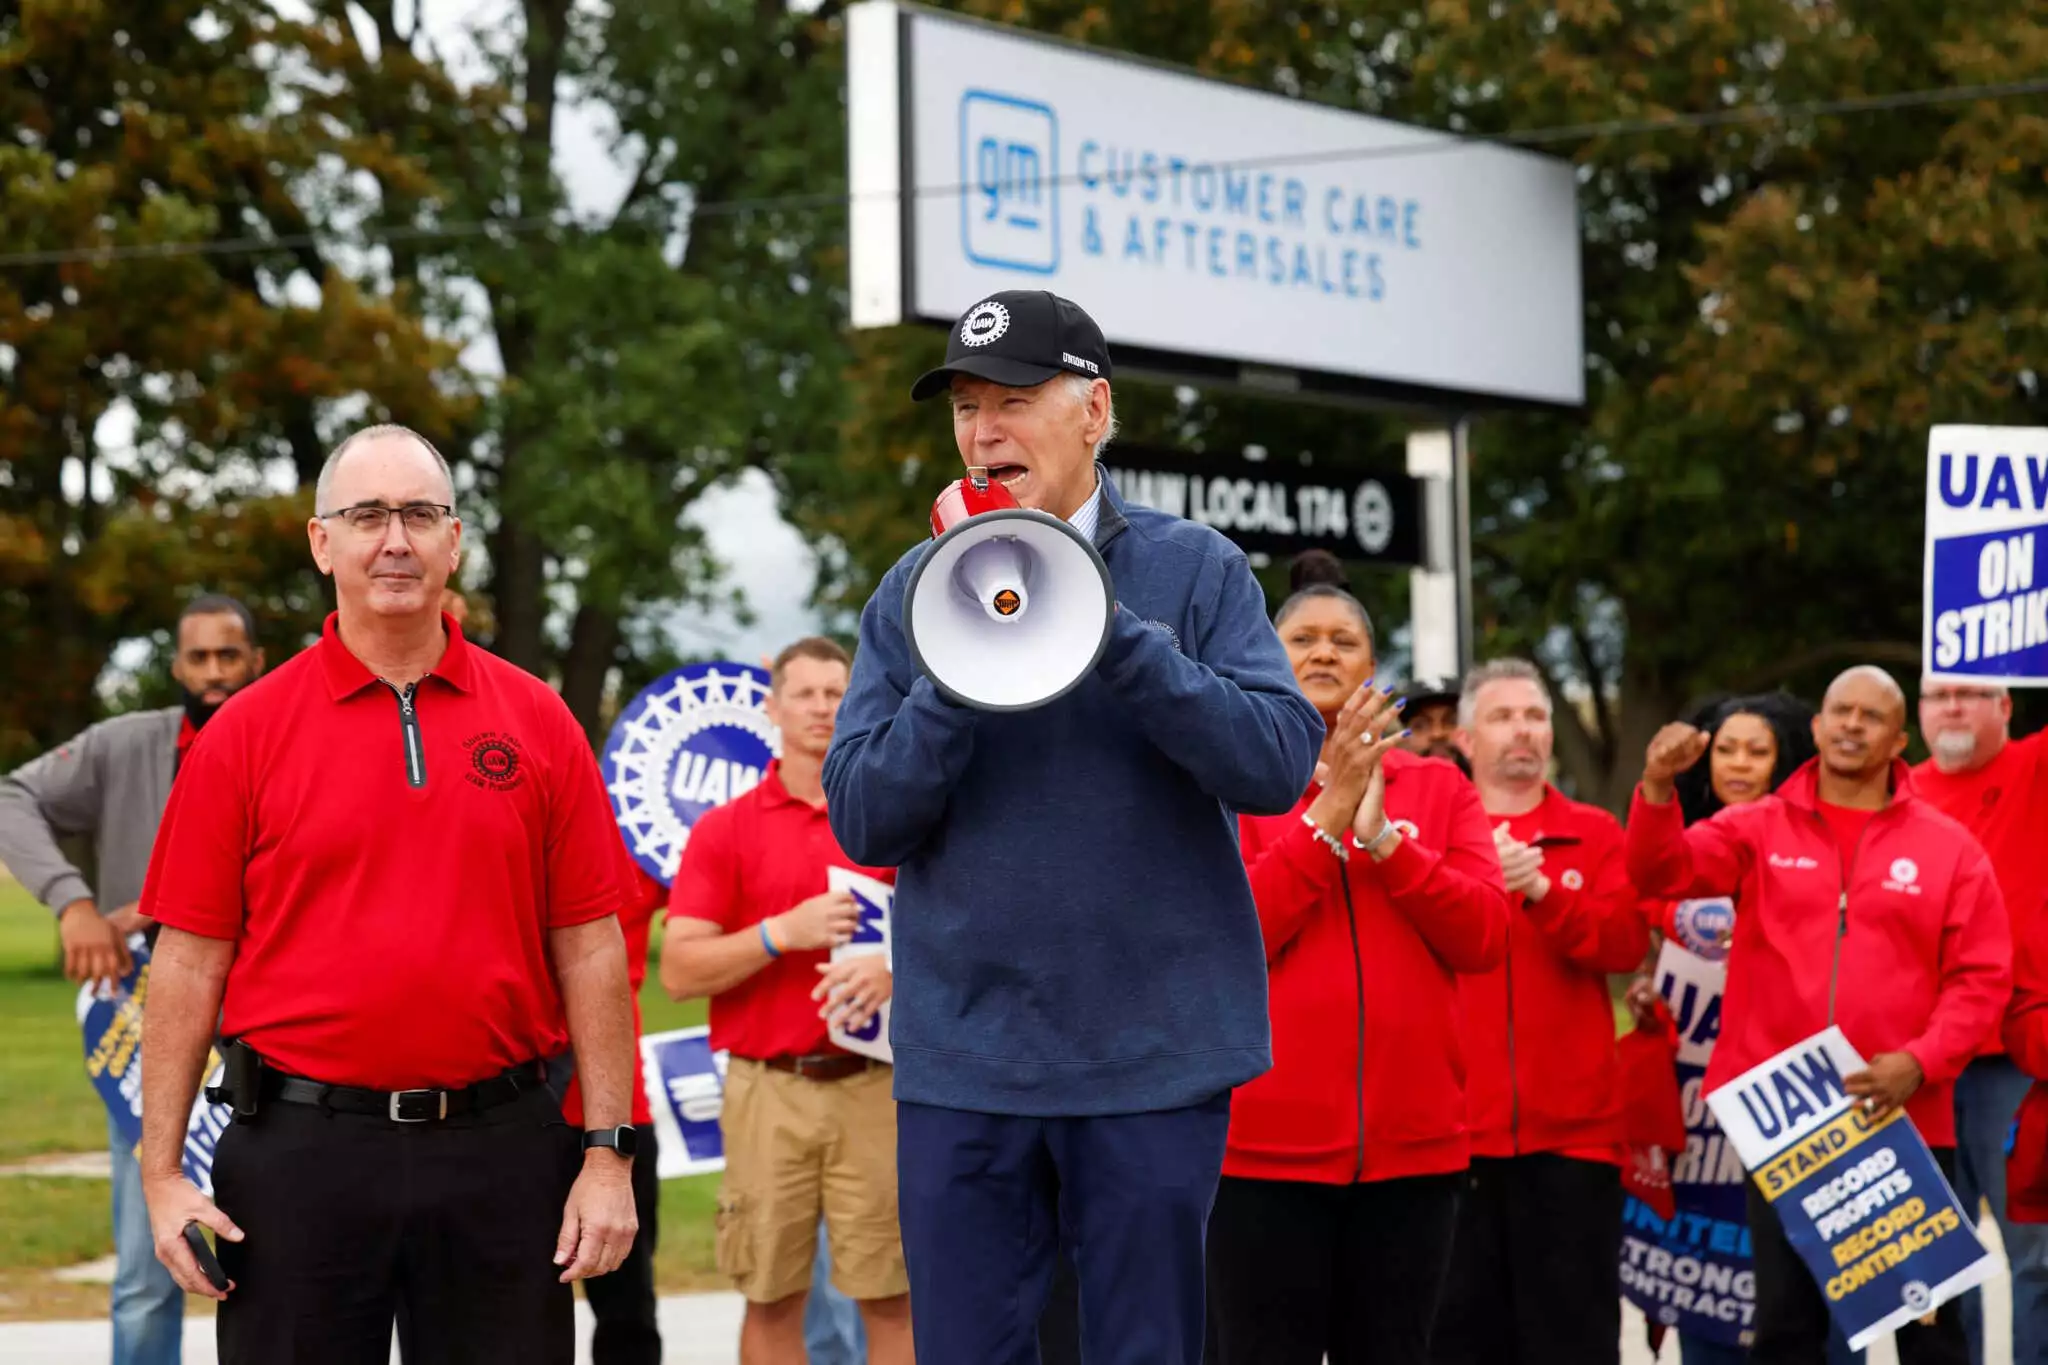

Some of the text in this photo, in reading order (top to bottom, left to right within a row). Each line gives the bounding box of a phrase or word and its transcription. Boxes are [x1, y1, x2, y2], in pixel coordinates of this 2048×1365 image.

[978, 137, 1039, 220] gm
[1078, 141, 1421, 249] CUSTOMER CARE
[1082, 204, 1385, 303] & AFTERSALES
[972, 317, 996, 330] UAW
[1062, 352, 1099, 374] UNION YES
[1190, 475, 1297, 535] LOCAL
[1295, 485, 1349, 539] 174
[1978, 533, 2035, 599] ON
[1935, 588, 2048, 668] STRIK
[1738, 1045, 1845, 1140] UAW
[1765, 1129, 1847, 1192] STAND
[1801, 1147, 1897, 1219] RECORD
[1814, 1168, 1913, 1241] PROFITS
[1831, 1196, 1926, 1269] RECORD
[1825, 1206, 1959, 1301] CONTRACTS
